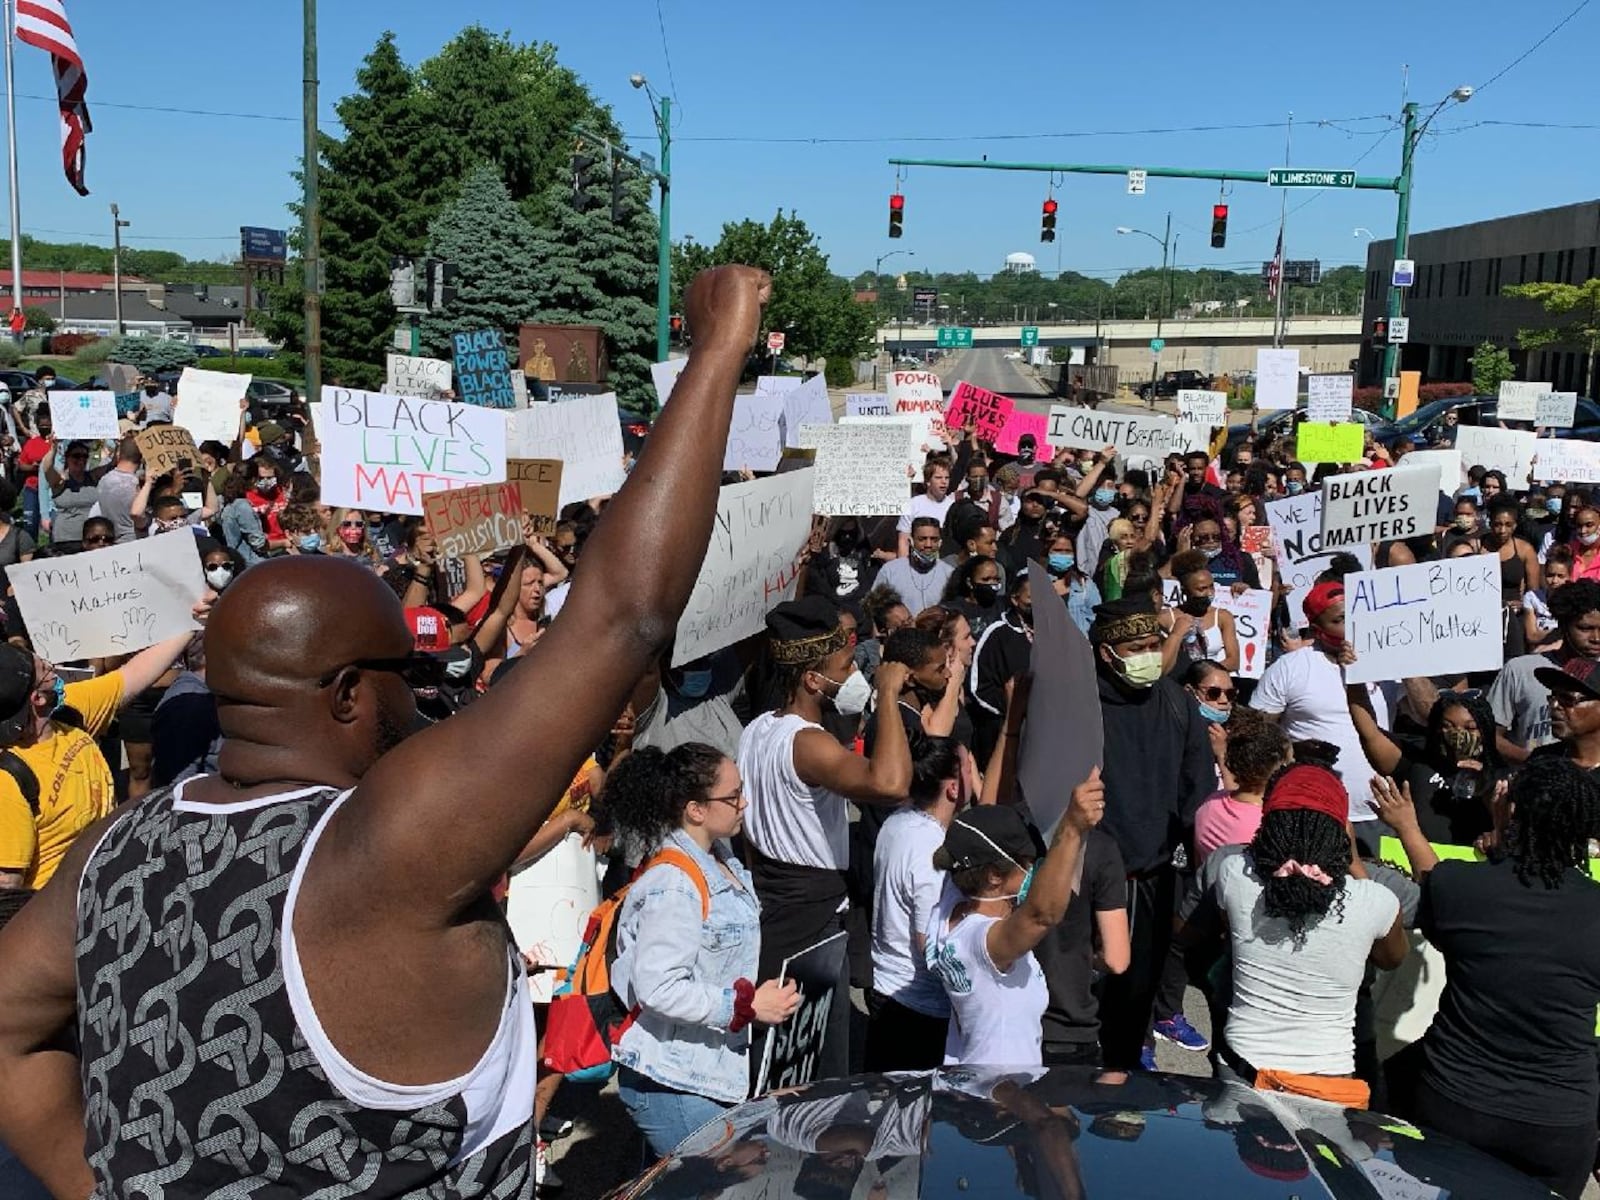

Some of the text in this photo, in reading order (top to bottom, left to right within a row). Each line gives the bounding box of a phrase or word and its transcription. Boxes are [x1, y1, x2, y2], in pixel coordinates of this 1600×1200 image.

[1270, 173, 1354, 184] N LIMESTONE ST
[455, 328, 503, 354] BLACK
[395, 356, 447, 376] BLACK
[456, 350, 509, 373] POWER
[460, 369, 512, 394] BLACK
[911, 389, 922, 397] IN
[961, 384, 1002, 410] BLUE
[1183, 393, 1217, 406] BLACK
[334, 389, 475, 442] BLACK
[858, 405, 891, 417] UNTIL
[962, 401, 1005, 428] LIVES
[1049, 413, 1067, 437] I
[1072, 415, 1125, 445] CANT
[363, 428, 492, 477] LIVES
[507, 461, 552, 483] ICE
[1329, 473, 1394, 502] BLACK
[840, 503, 866, 514] LIVES
[1274, 504, 1308, 526] WE
[1353, 494, 1409, 518] LIVES
[1326, 516, 1416, 547] MATTERS
[34, 569, 79, 593] My
[1351, 564, 1501, 614] ALL Black
[71, 587, 143, 615] Matters
